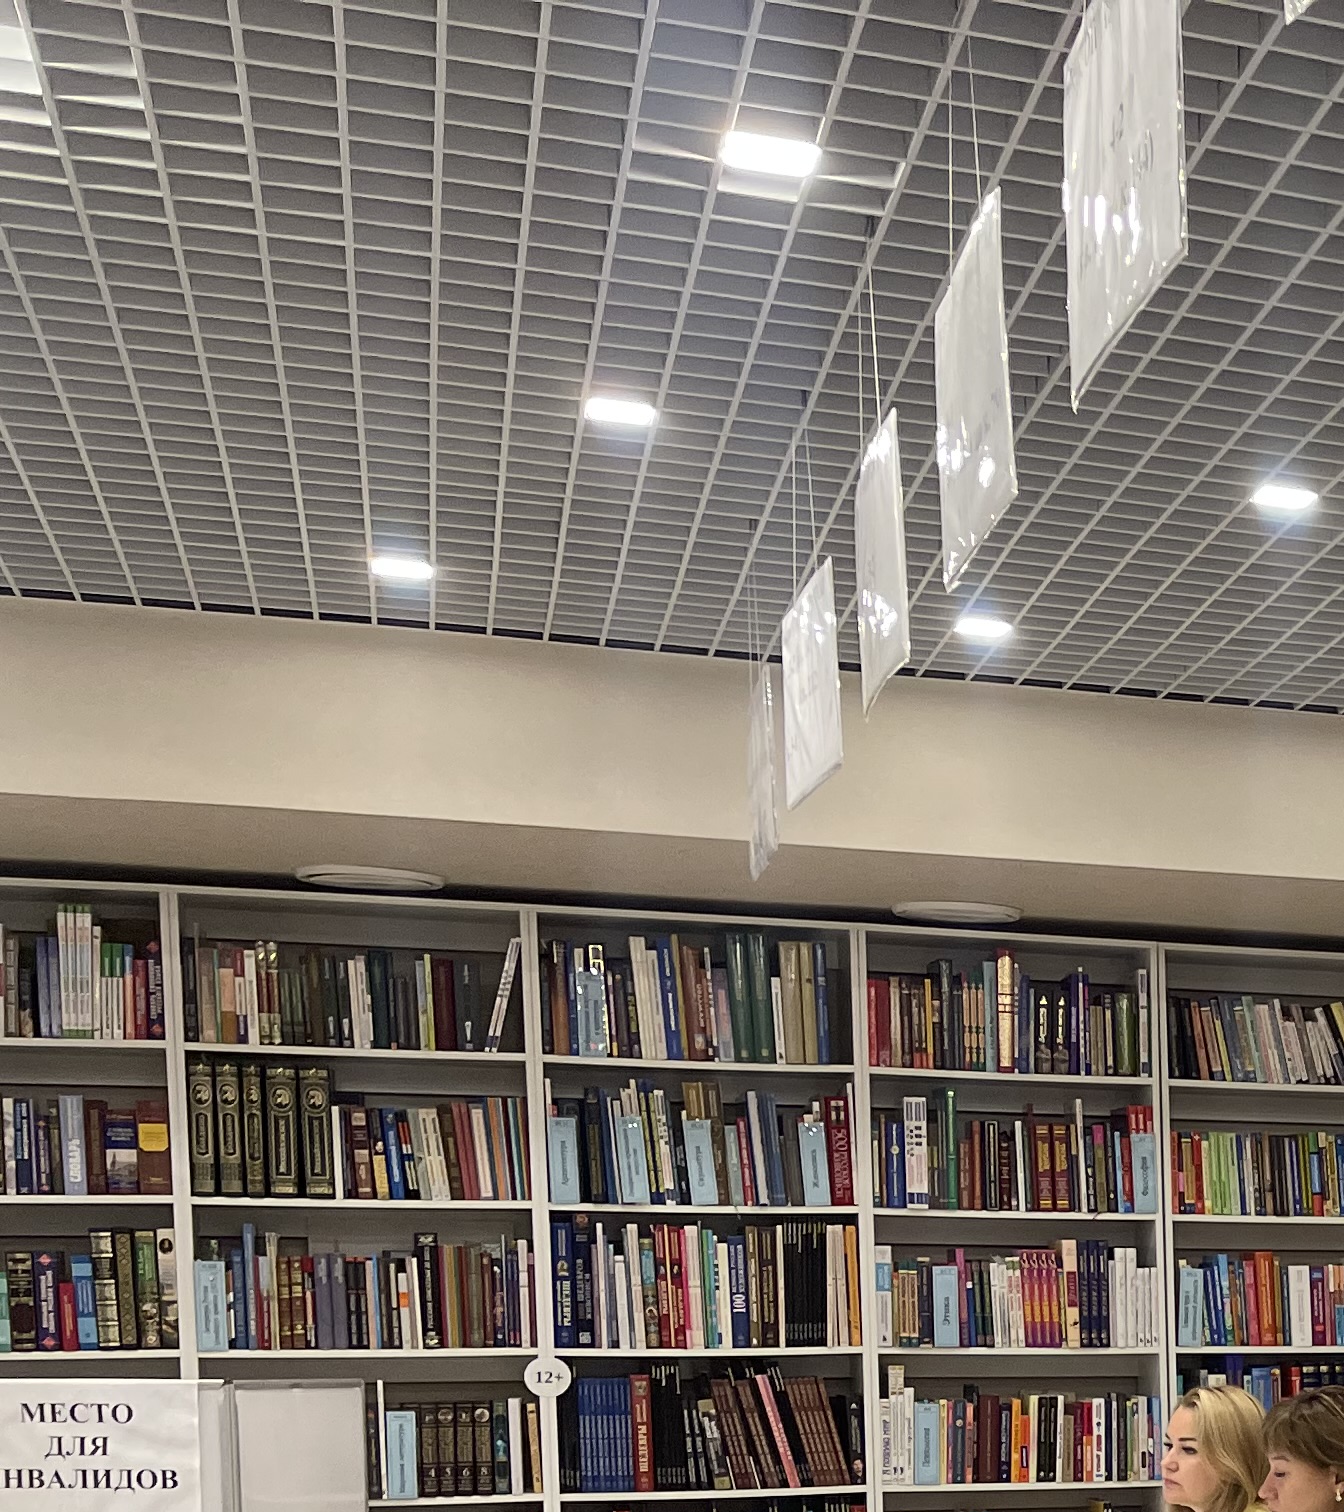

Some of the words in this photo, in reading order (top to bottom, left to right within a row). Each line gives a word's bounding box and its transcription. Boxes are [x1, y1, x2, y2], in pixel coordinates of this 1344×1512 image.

[732, 1294, 746, 1313] 100
[536, 1371, 564, 1384] 12+
[20, 1402, 133, 1424] МЕСТО
[44, 1435, 109, 1461] ДЛЯ
[0, 1468, 179, 1494] НВАЛИДОВ
[462, 1467, 470, 1476] 6
